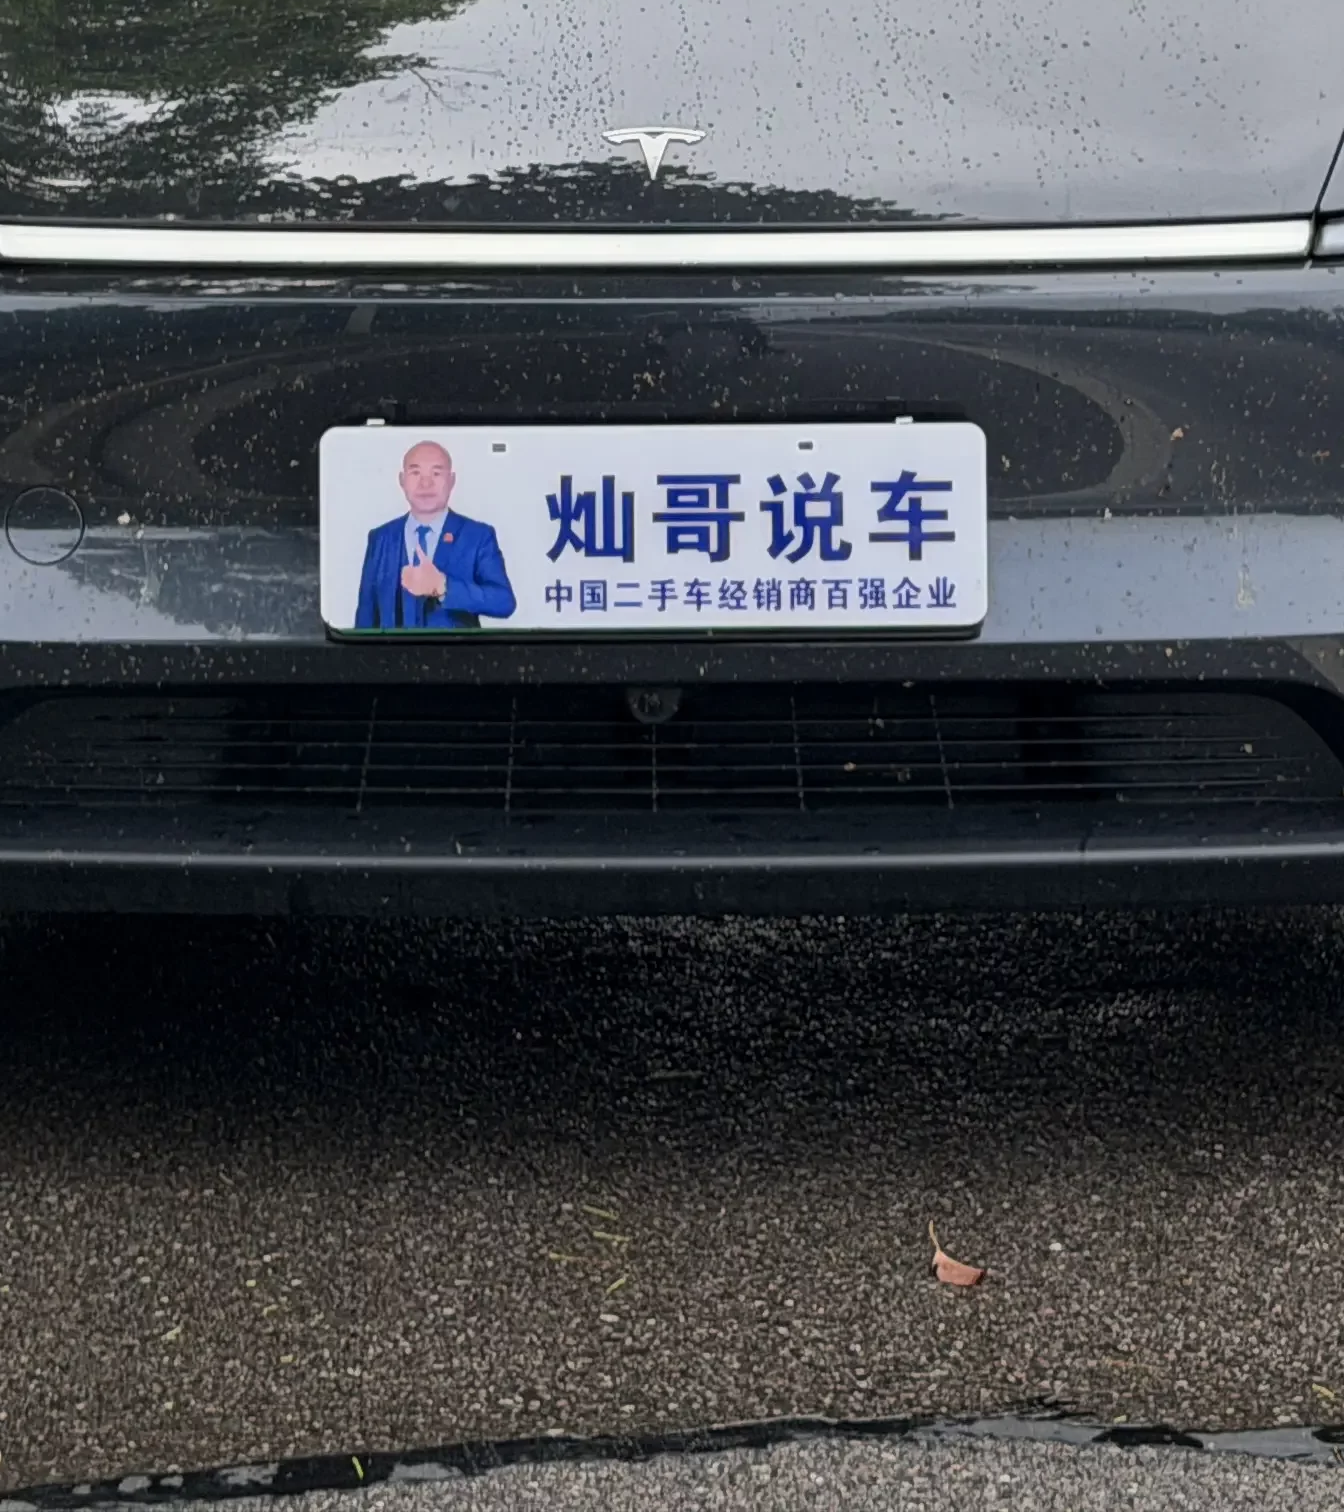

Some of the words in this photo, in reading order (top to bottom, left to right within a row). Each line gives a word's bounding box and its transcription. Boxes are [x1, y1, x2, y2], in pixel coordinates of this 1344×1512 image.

[545, 470, 956, 564] 灿哥说车
[544, 576, 957, 613] 中国二手车经销商百强企业
